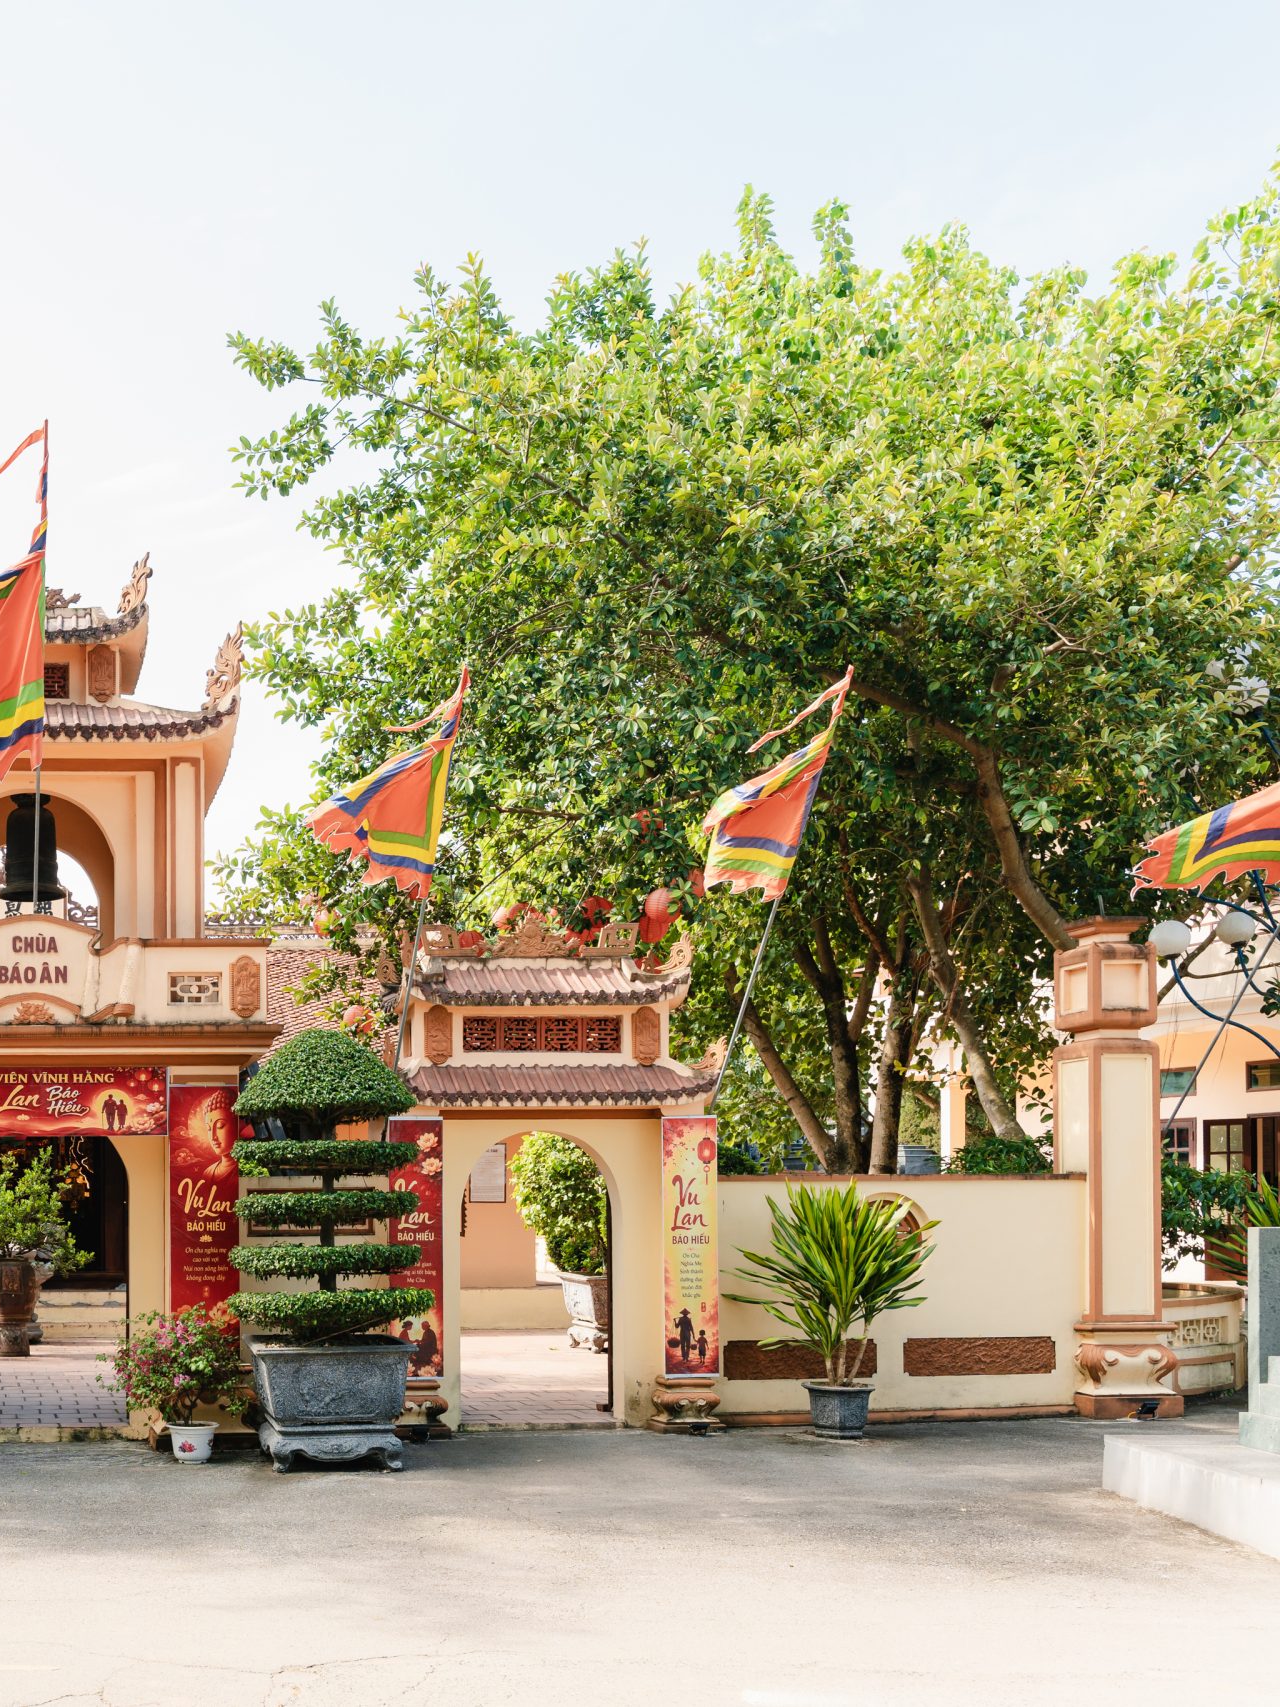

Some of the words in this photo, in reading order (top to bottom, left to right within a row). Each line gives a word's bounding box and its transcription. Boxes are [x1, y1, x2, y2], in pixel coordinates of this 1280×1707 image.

[12, 933, 58, 953] CHÙA
[29, 1072, 69, 1084] VĨNH
[73, 1070, 115, 1084] HẰNG
[45, 1085, 81, 1101] Báo
[46, 1099, 90, 1118] Hiếu
[177, 1177, 206, 1214] Vu
[197, 1184, 233, 1218] Lan
[672, 1174, 701, 1207] Vu
[186, 1219, 205, 1232] BÁO
[206, 1218, 226, 1232] HIẾU
[397, 1211, 436, 1230] Lan
[670, 1205, 709, 1232] Lan
[397, 1230, 414, 1241] BÁO
[415, 1229, 435, 1241] HIẾU
[672, 1233, 689, 1245] BÁO
[691, 1232, 710, 1245] HIẾU
